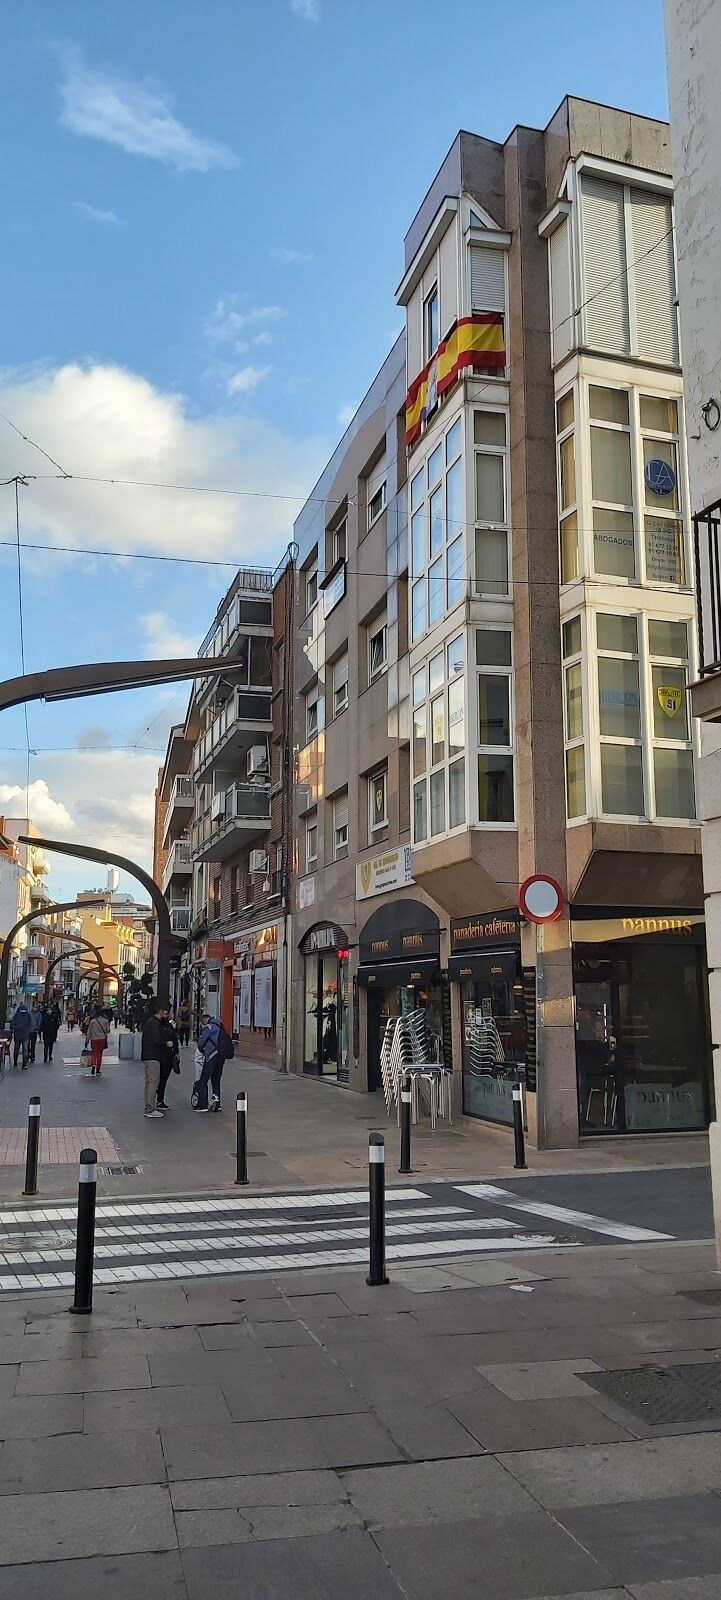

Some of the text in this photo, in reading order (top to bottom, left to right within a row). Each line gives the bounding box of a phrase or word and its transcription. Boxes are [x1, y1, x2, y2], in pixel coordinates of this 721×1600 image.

[593, 534, 633, 547] ABOGADOS
[453, 920, 484, 940] panadería
[621, 918, 692, 935] pannus
[402, 932, 424, 951] pannus
